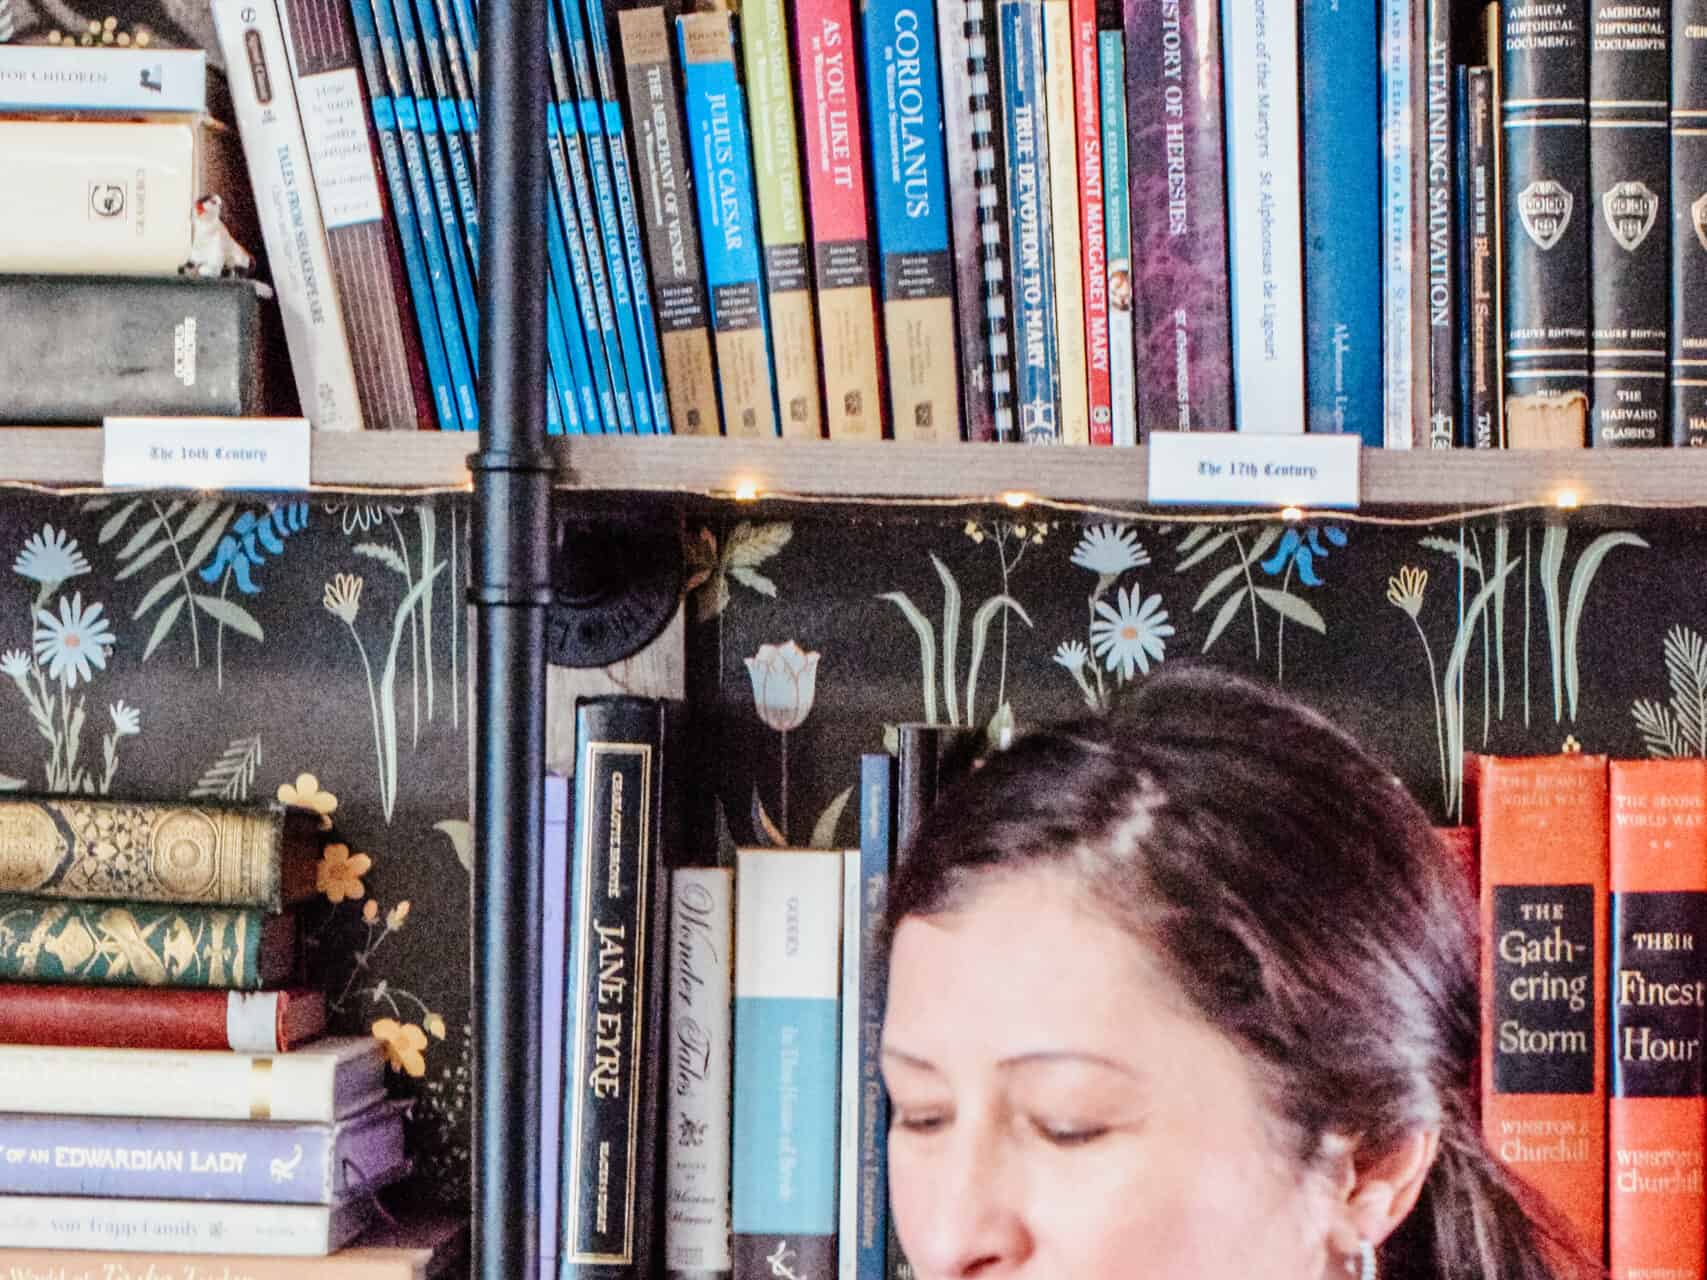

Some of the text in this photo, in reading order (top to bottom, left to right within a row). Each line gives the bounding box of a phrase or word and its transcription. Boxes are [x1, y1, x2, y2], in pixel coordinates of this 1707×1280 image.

[1507, 20, 1574, 34] HISTORICAL
[1595, 22, 1665, 35] HISTORICAL
[1600, 6, 1661, 18] AMERICAN
[1594, 39, 1666, 50] DOCUMENTS
[646, 66, 661, 99] THE
[1256, 62, 1271, 88] the
[823, 18, 853, 189] AS YOU LIKE IT
[894, 9, 930, 218] CORIOLANUS
[1164, 85, 1183, 119] OF
[704, 92, 733, 164] JULIUS
[1015, 103, 1034, 158] TRUE
[1255, 93, 1271, 160] Martyrs
[1086, 140, 1101, 197] SAINT
[1166, 122, 1187, 237] HERESIES
[1429, 41, 1449, 327] ATTAINING SALVATION
[286, 191, 303, 226] FROM
[664, 192, 678, 213] OF
[718, 168, 743, 250] CAESAR
[1018, 163, 1040, 269] DEVOTION
[668, 216, 687, 278] VENICE
[1087, 203, 1104, 311] MARGARET
[1023, 274, 1041, 304] TO
[1026, 309, 1045, 368] MARY
[1091, 316, 1107, 372] MARY
[1616, 390, 1642, 401] THE
[1601, 409, 1658, 420] HARVARD
[1601, 428, 1656, 439] CLASSICS
[151, 447, 268, 463] The 16th Century
[1199, 462, 1318, 479] The 17th Century
[1615, 795, 1647, 808] THE
[1615, 814, 1666, 826] WORLD
[1520, 904, 1564, 920] THE
[1499, 926, 1587, 967] Gath-
[1632, 933, 1694, 951] THEIR
[675, 883, 718, 1098] Wonder Tales
[1509, 971, 1588, 1012] ering
[1618, 970, 1705, 1007] Finest
[587, 919, 625, 1099] JANE EYRE
[1499, 1020, 1588, 1054] Storm
[1623, 1027, 1699, 1061] Hour
[1501, 1120, 1576, 1135] WINSTON
[7, 1146, 247, 1174] OF AN EDWARDIAN LADY
[1500, 1137, 1590, 1163] Churchill
[1616, 1168, 1704, 1193] Churchill
